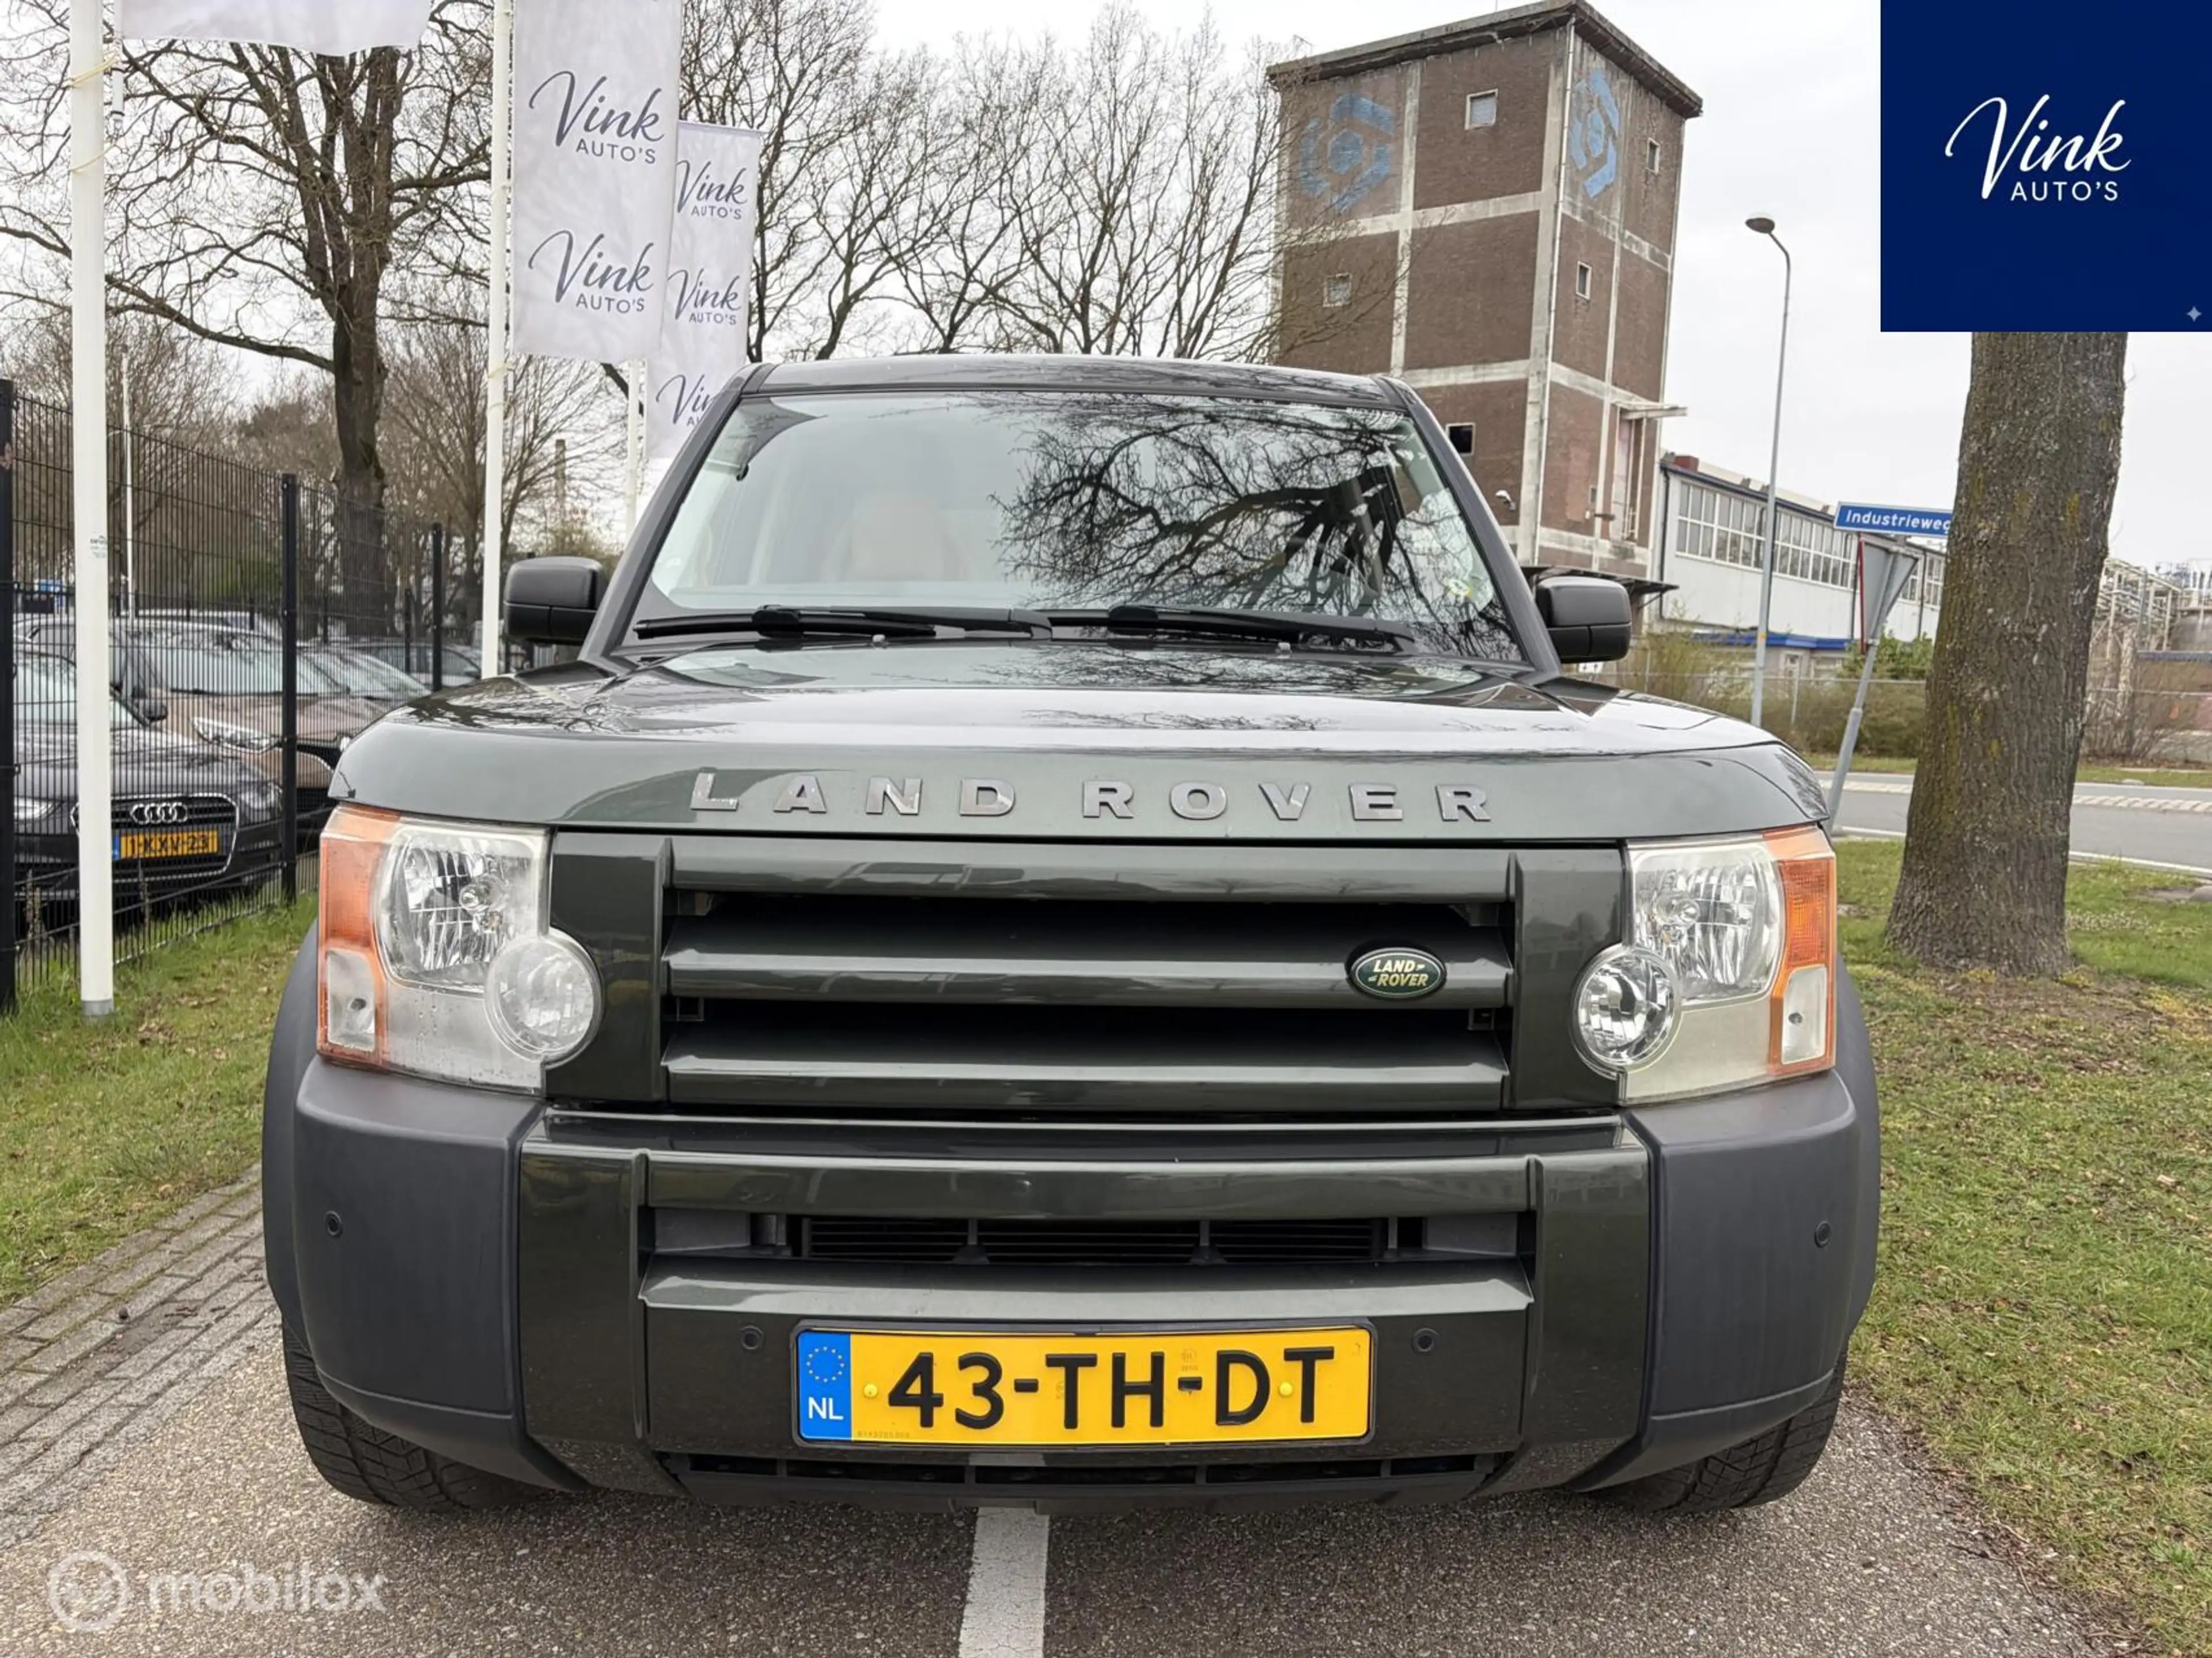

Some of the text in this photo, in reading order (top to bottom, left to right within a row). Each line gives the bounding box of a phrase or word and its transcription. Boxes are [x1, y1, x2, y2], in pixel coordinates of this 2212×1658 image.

[528, 70, 665, 147] Vink
[575, 138, 656, 165] AUTO'S
[675, 159, 748, 214] Vink
[691, 204, 742, 220] AUTO'S
[528, 229, 654, 303] Vink
[575, 293, 645, 314] AUTO'S
[666, 267, 742, 320] Vink
[688, 312, 737, 326] AUTO'S
[690, 772, 1491, 822] LAND ROVER
[1373, 959, 1416, 973] LAND
[1377, 973, 1429, 987] ROVER
[808, 1346, 1335, 1430] NL 43-TH-DT
